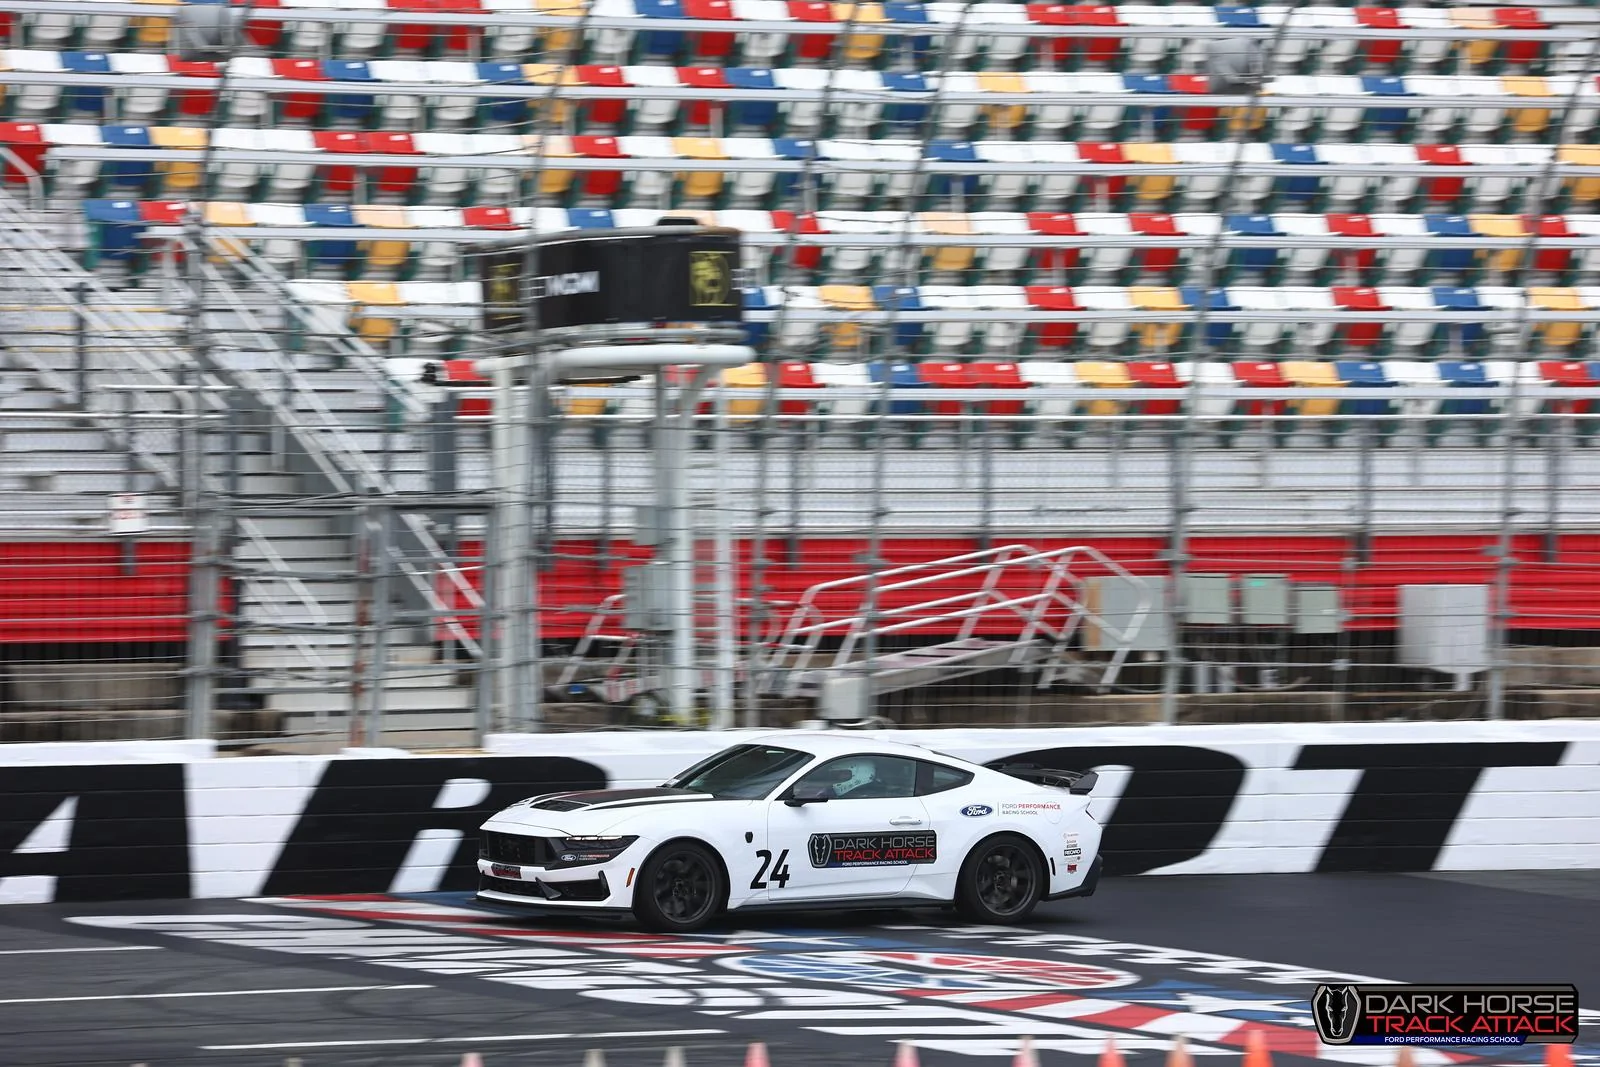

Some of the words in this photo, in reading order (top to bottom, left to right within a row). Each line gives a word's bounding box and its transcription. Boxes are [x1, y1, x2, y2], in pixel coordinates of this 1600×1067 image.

[965, 805, 989, 816] Ford
[834, 839, 876, 850] DARK
[880, 836, 934, 848] HORSE
[833, 850, 881, 861] TRACK
[884, 848, 934, 860] ATTACK
[750, 849, 790, 889] 24
